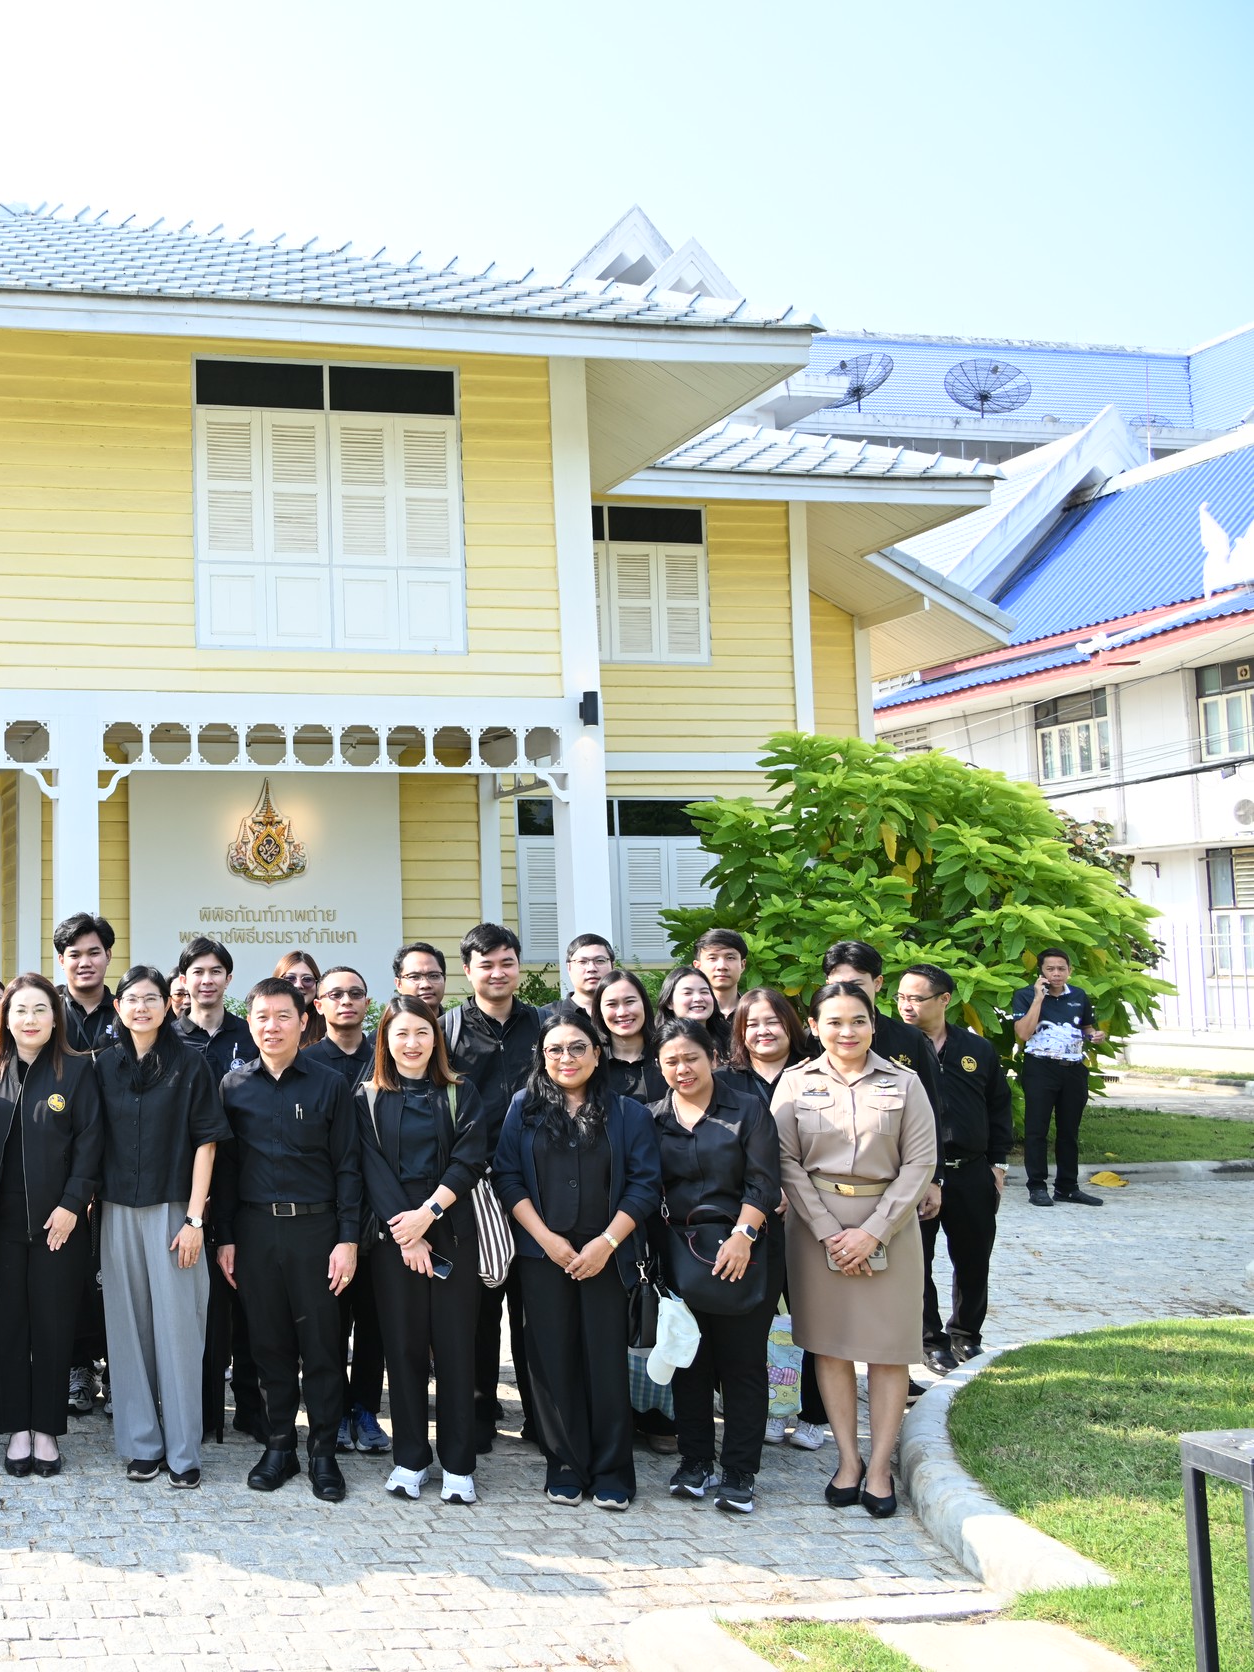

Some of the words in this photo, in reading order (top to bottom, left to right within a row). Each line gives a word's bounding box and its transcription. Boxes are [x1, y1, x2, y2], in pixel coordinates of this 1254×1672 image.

[199, 905, 337, 923] พิพิธภัณฑ์ภาพถ่าย
